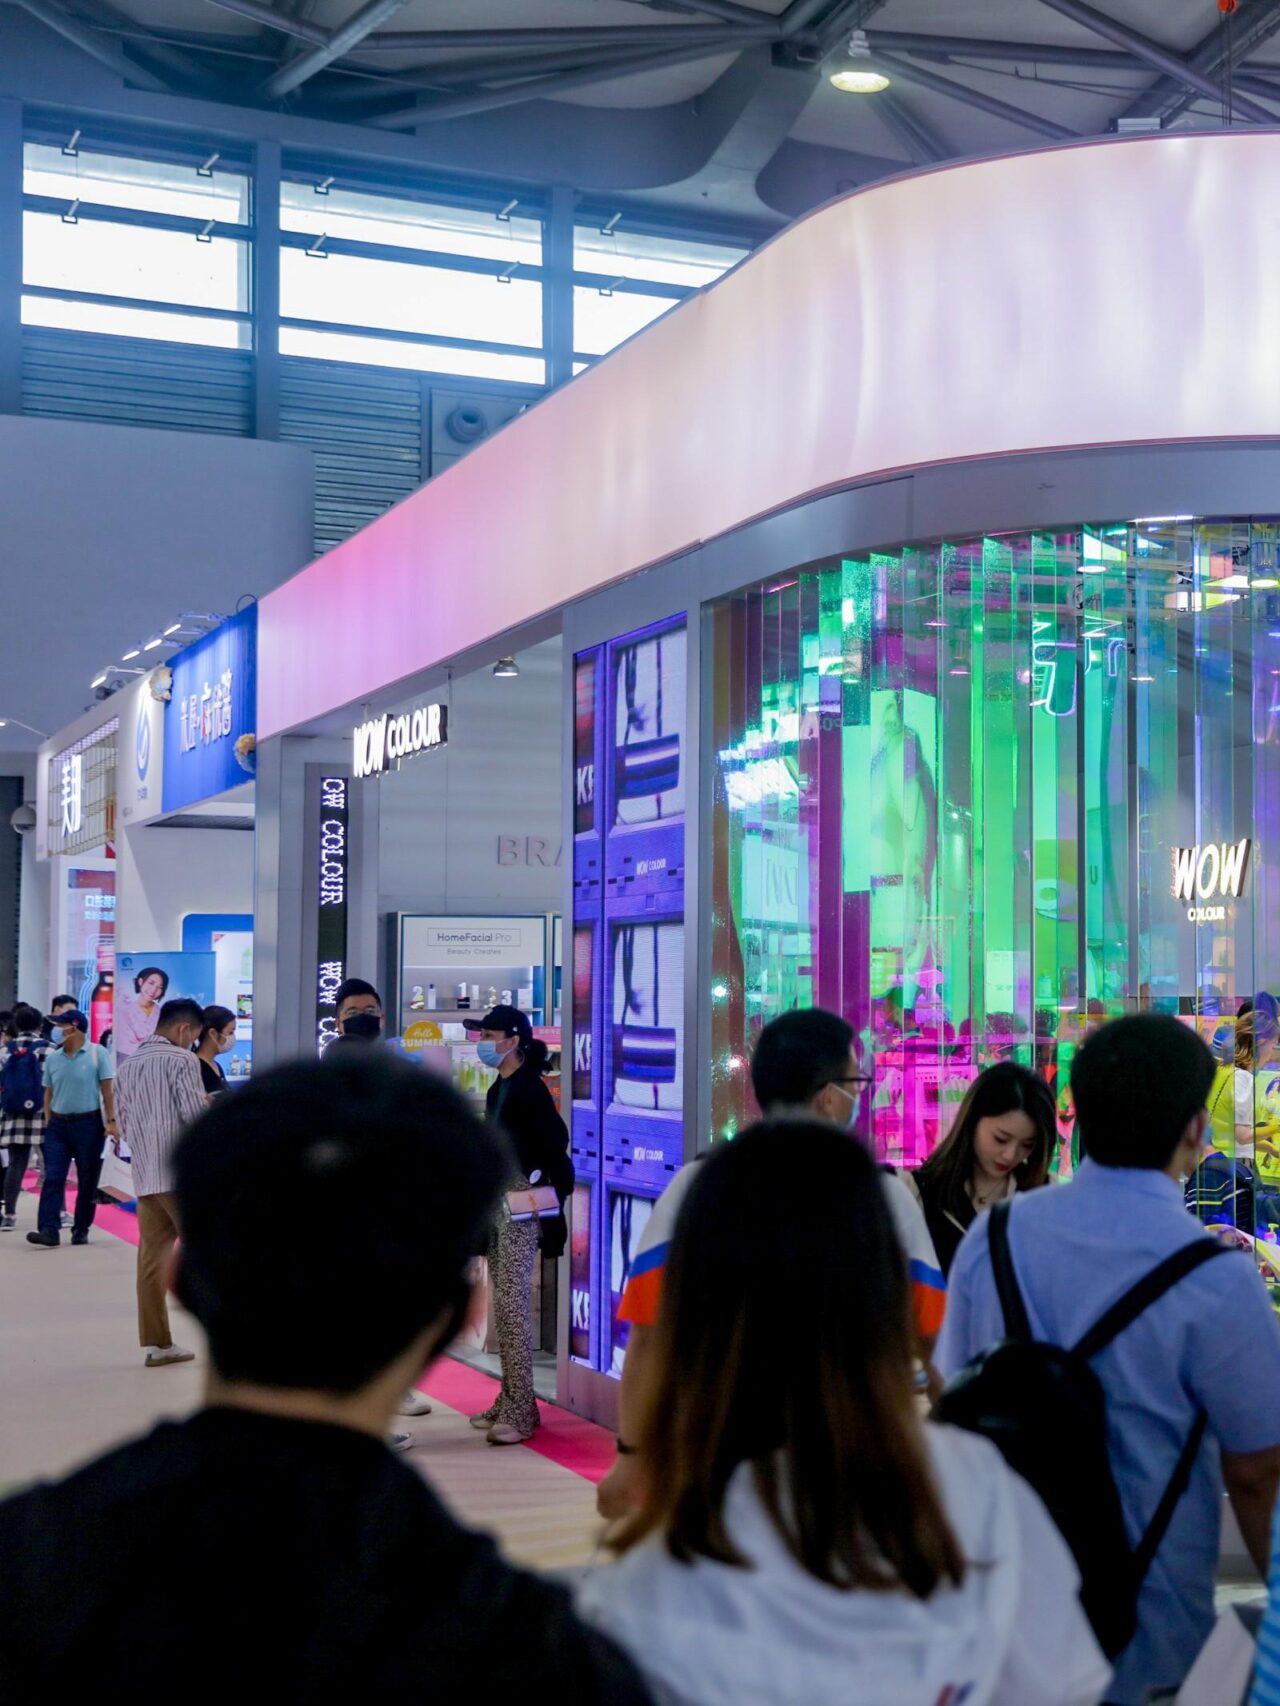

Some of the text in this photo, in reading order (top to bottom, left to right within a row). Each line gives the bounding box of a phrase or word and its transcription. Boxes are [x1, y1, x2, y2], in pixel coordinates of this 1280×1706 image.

[354, 704, 442, 778] WOW COLOUR
[321, 820, 345, 906] COLOUR
[1175, 838, 1248, 900] WOW
[437, 932, 512, 942] HomeFacial Pro
